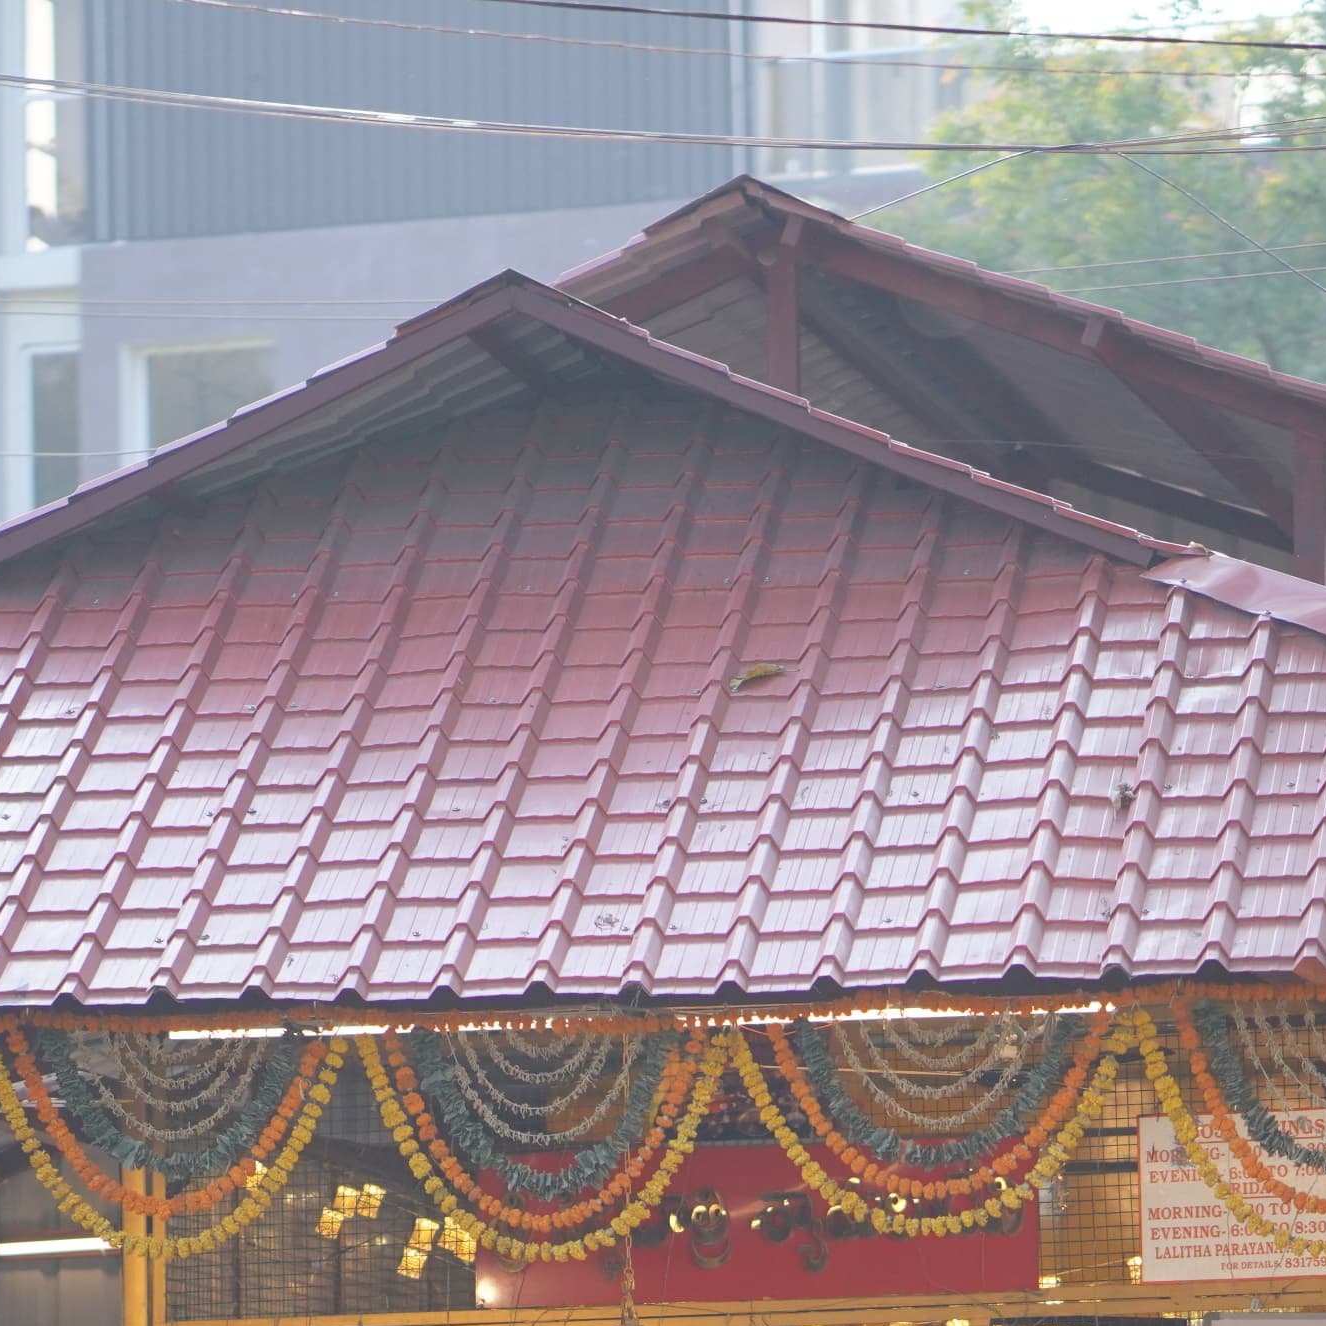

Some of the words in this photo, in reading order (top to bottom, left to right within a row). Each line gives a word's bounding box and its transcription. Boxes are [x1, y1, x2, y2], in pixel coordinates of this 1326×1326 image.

[1147, 1146, 1225, 1163] MORG-
[1149, 1168, 1211, 1183] EVENI
[1229, 1167, 1253, 1180] 6:0
[1267, 1165, 1288, 1178] TO
[1228, 1180, 1273, 1195] RIDA
[1147, 1204, 1227, 1221] MORNING-
[1269, 1202, 1290, 1216] TO
[1150, 1224, 1226, 1241] EVENING-
[1295, 1219, 1326, 1234] 8:30
[1155, 1245, 1212, 1260] LALITHA
[1214, 1241, 1282, 1258] PARAYAN
[1220, 1262, 1239, 1271] FOR
